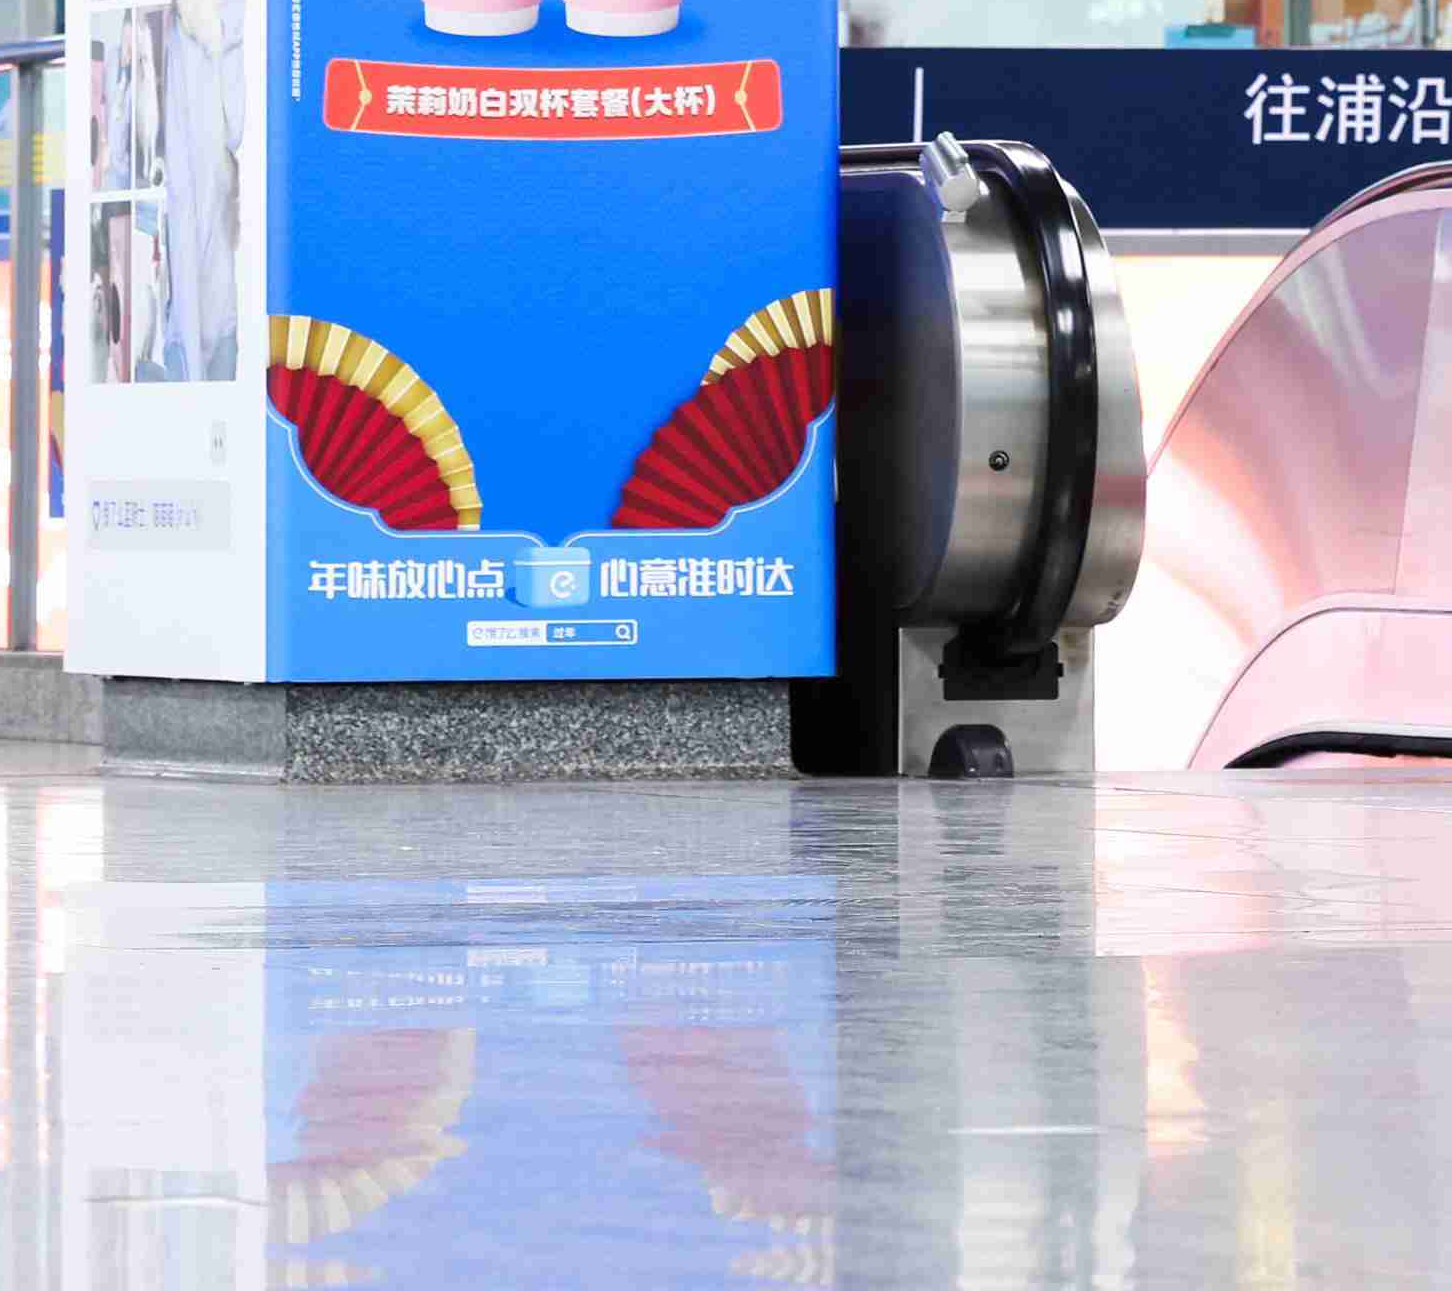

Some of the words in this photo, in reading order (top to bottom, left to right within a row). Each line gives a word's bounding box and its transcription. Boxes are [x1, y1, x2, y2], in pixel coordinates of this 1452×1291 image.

[386, 84, 717, 120] 茉莉奶白双杯套餐(大杯)
[307, 559, 506, 600] 年味放心点
[599, 557, 796, 597] 心意准时达
